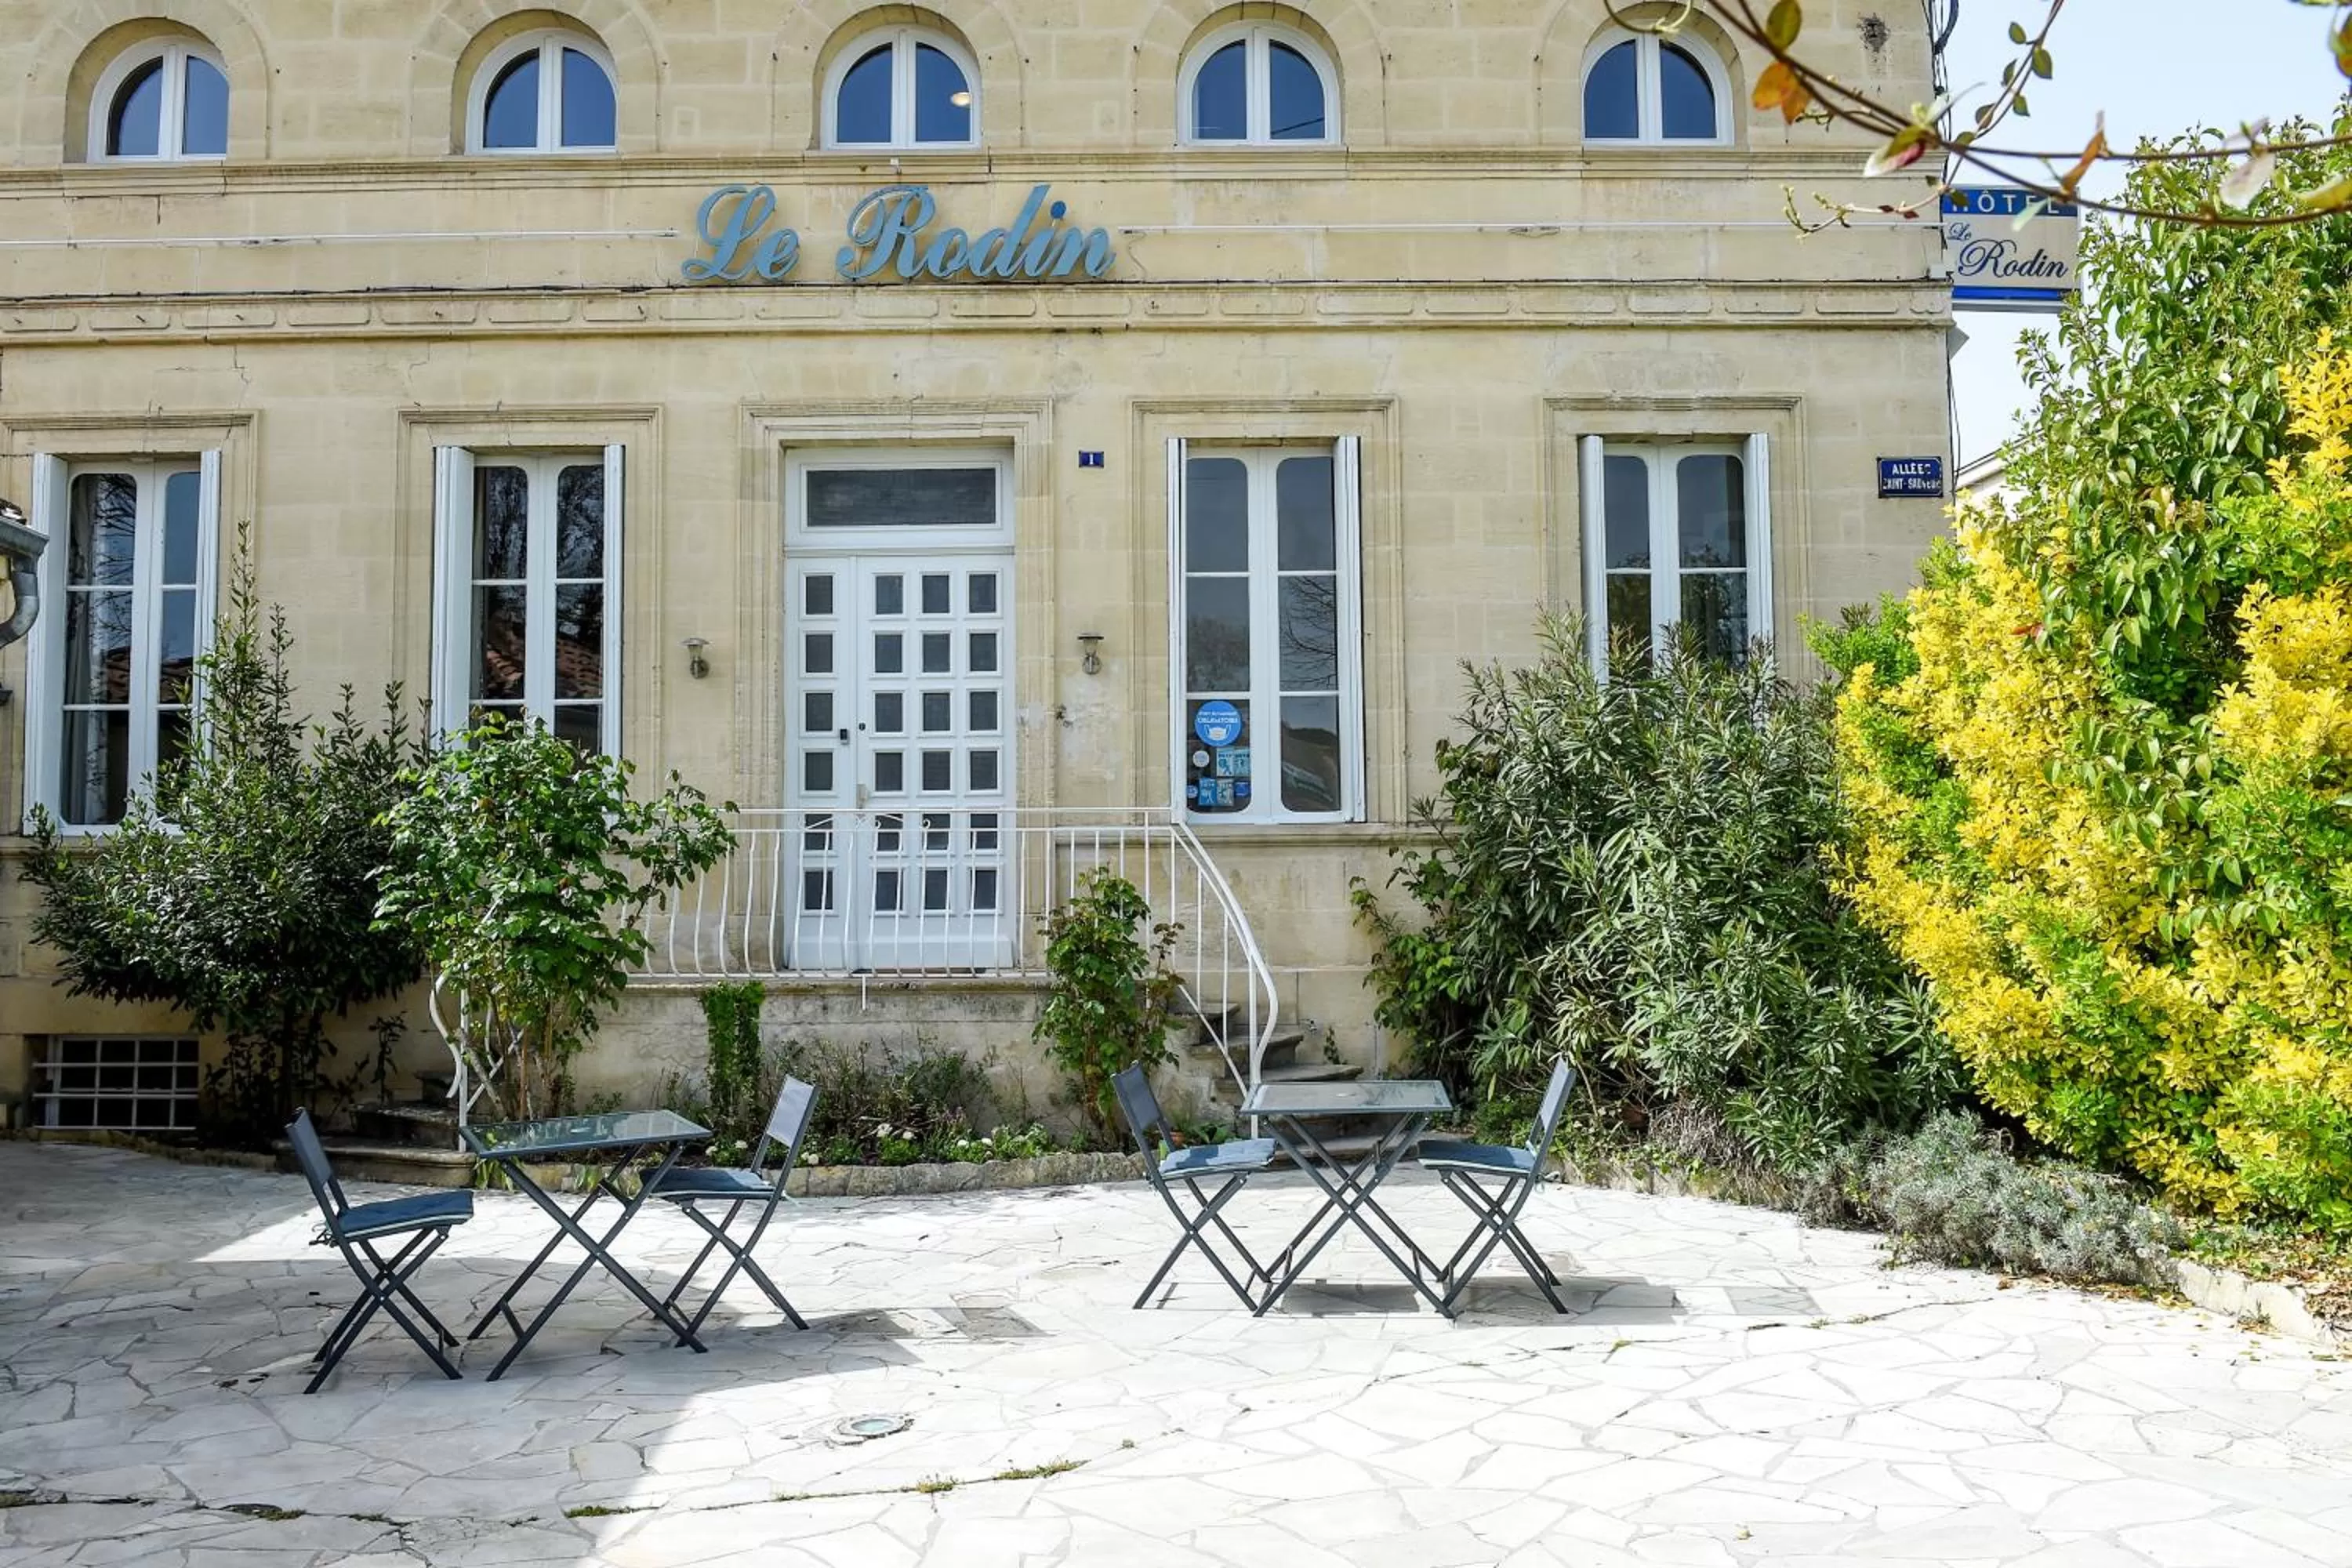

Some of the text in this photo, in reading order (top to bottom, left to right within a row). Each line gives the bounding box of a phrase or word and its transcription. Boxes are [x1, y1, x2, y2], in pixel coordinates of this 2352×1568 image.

[1952, 190, 2060, 214] ÔTEL
[681, 183, 1116, 281] Le Rodin
[1947, 222, 1972, 241] Le
[1958, 238, 2069, 278] Rodin
[1089, 454, 1094, 465] 1
